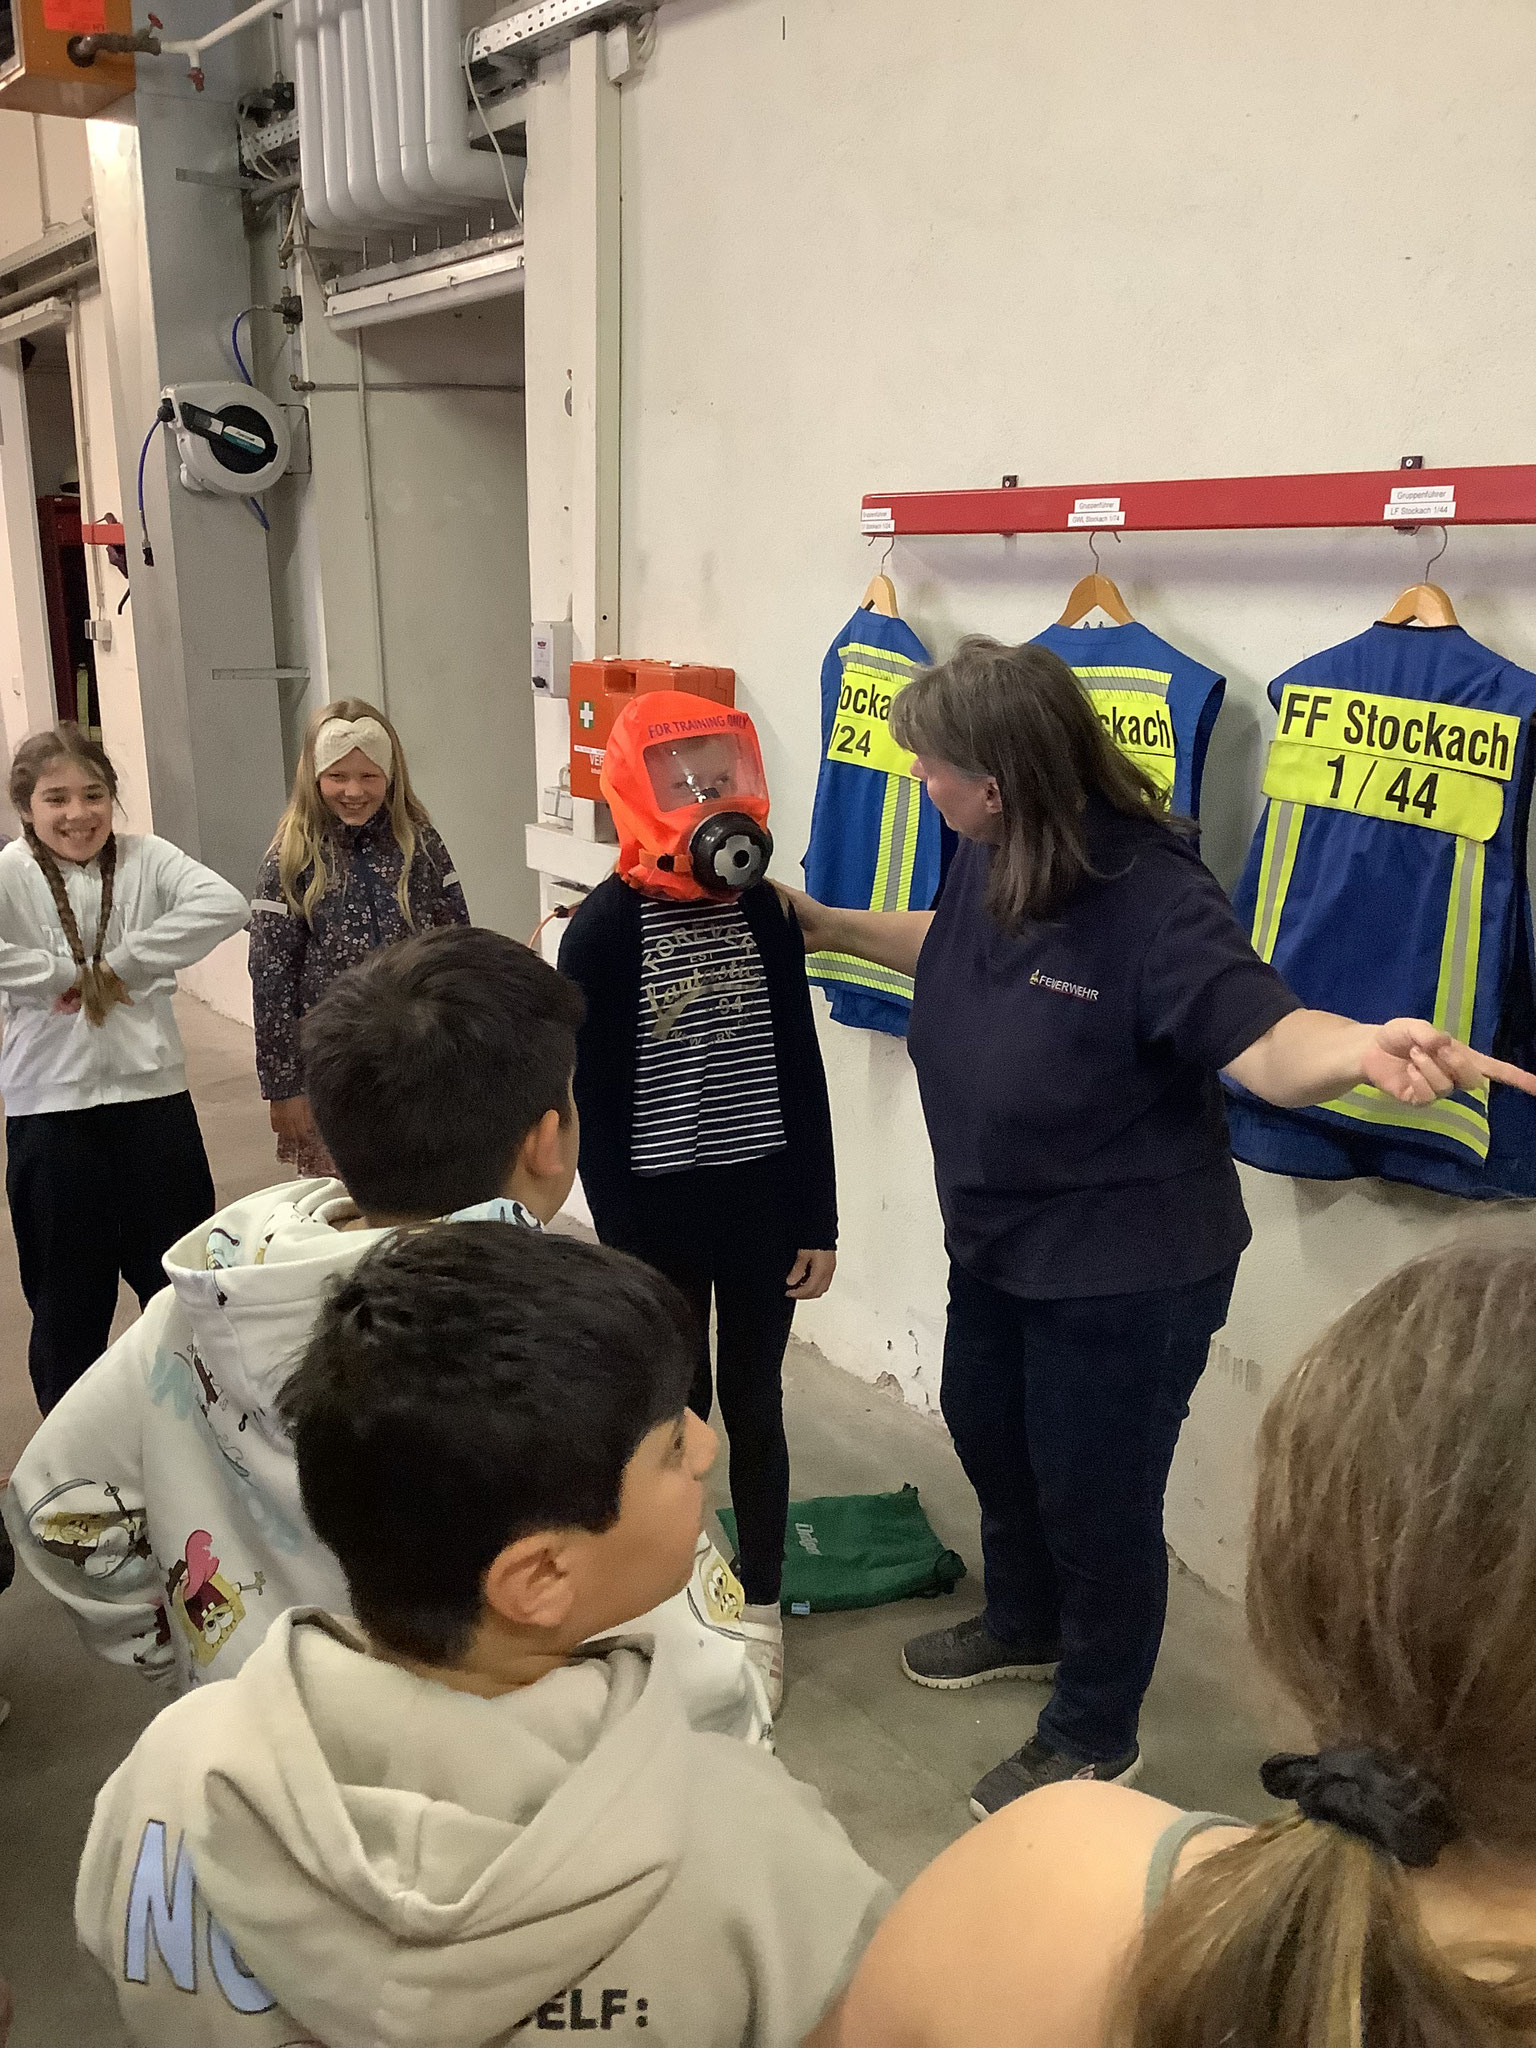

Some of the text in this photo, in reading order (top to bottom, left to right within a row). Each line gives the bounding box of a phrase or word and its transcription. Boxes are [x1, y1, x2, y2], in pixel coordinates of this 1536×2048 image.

[1401, 506, 1432, 515] Stockach
[840, 678, 892, 721] ocka
[648, 714, 750, 739] FOR TRAINING ONLY
[1099, 706, 1171, 749] kach
[1282, 692, 1511, 772] FF Stockach
[1039, 975, 1099, 1001] FEUERWEHR
[535, 1988, 649, 2031] ELF:
